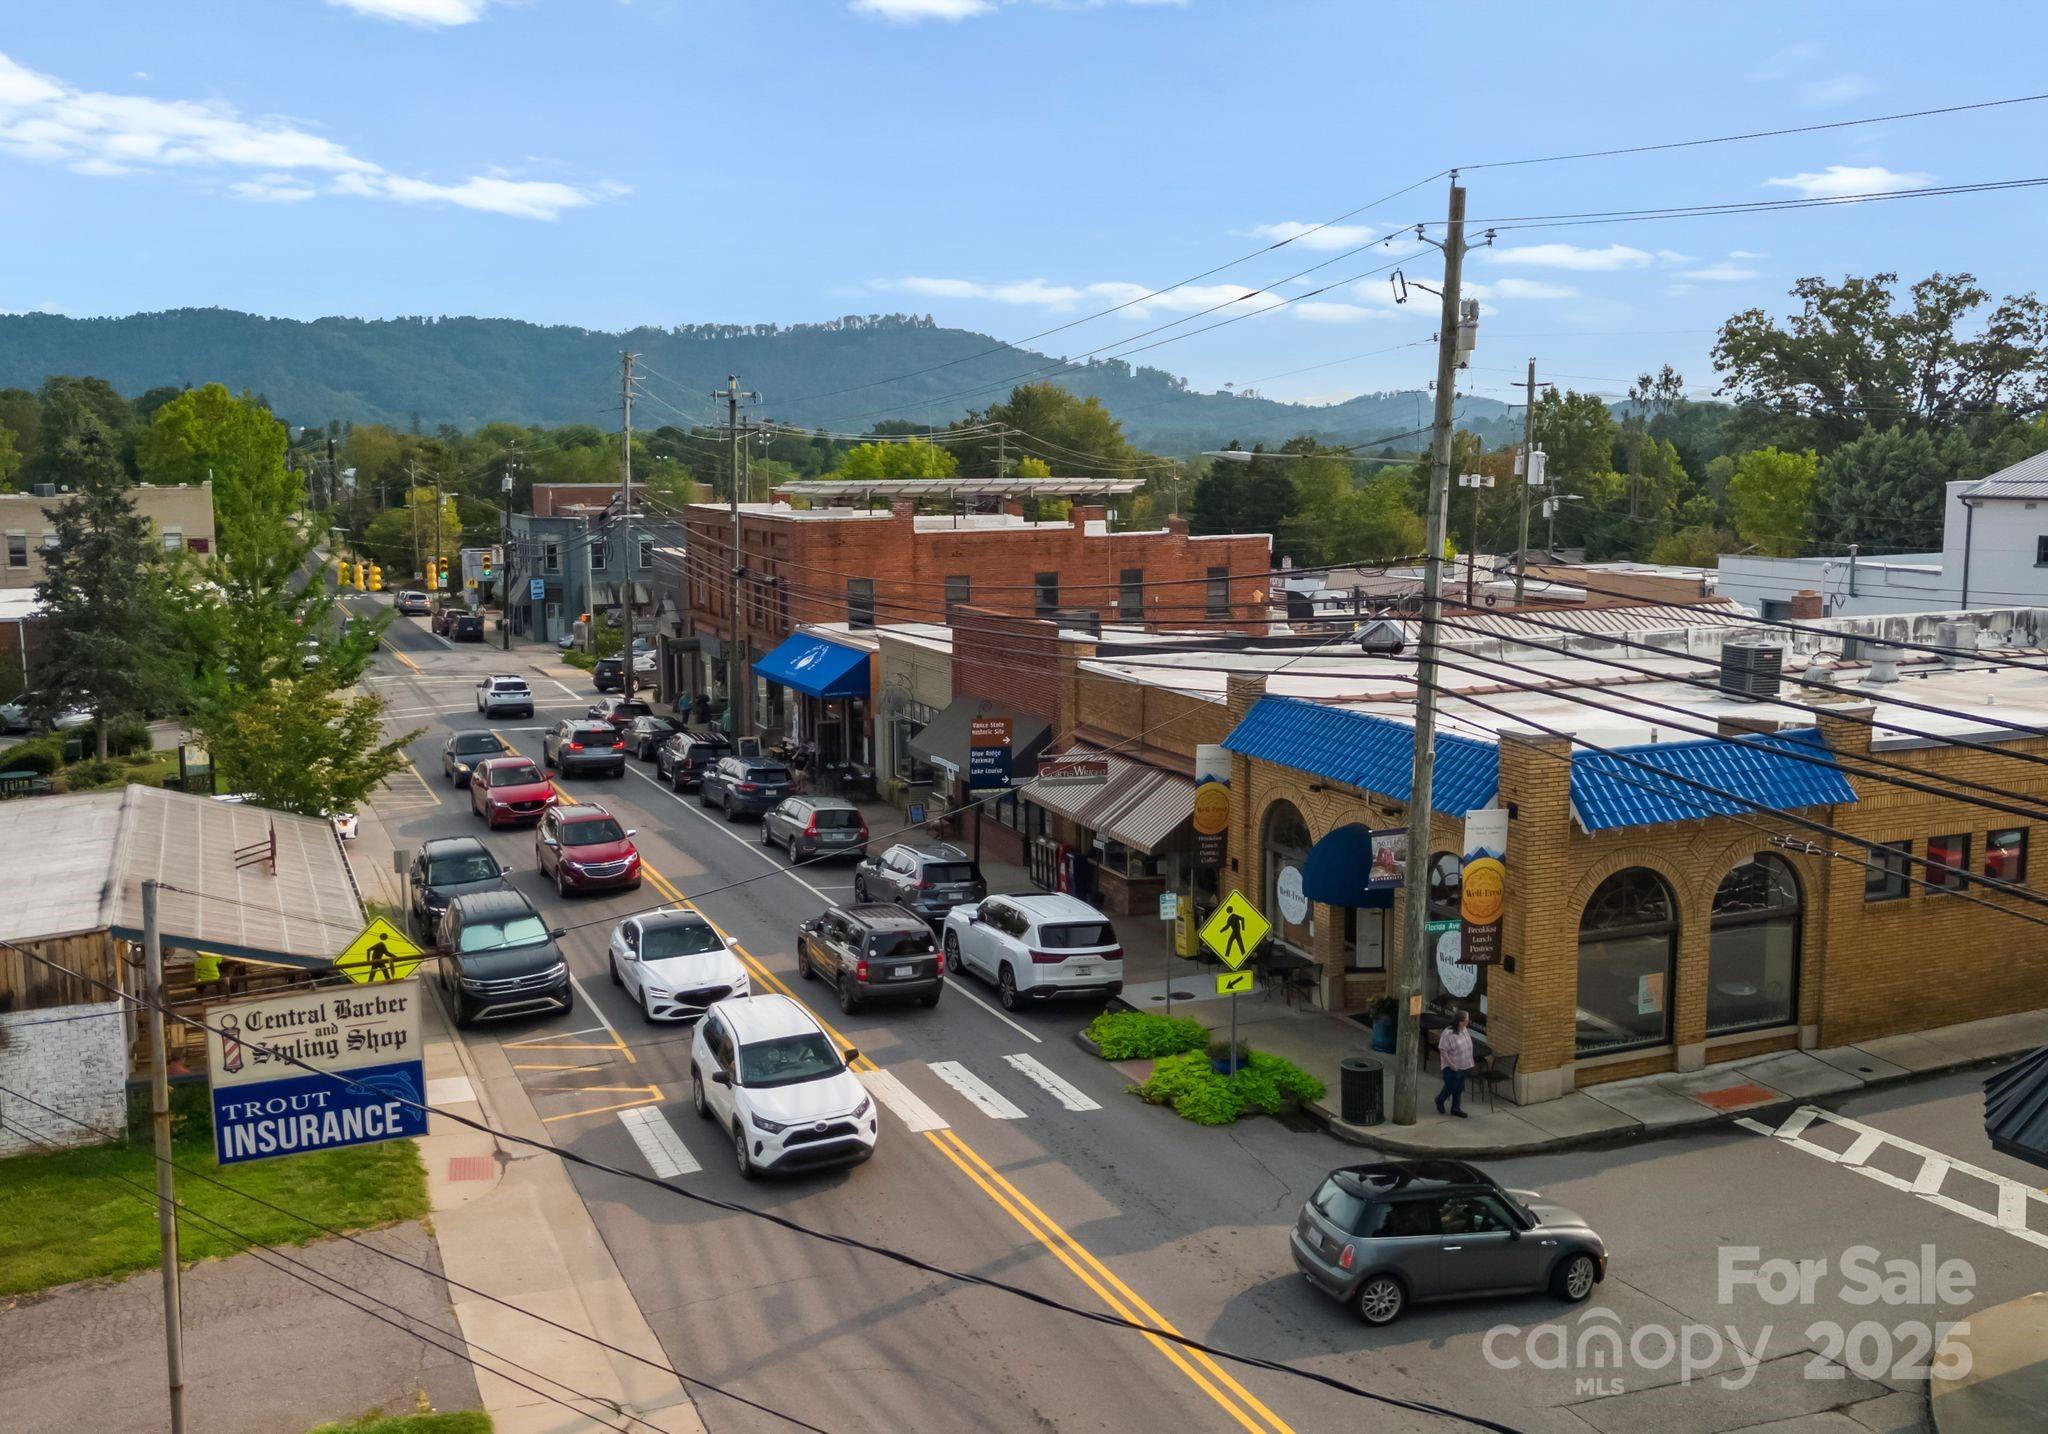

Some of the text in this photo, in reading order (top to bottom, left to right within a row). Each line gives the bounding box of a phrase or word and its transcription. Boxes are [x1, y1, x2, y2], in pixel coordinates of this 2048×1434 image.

[1424, 923, 1446, 931] Florida
[1468, 926, 1497, 934] Breakfast
[1472, 935, 1492, 943] Lunch
[1470, 945, 1494, 953] Pastries
[1471, 953, 1492, 961] Coffee
[245, 996, 408, 1031] Central Barber
[315, 1023, 339, 1037] and
[252, 1028, 408, 1065] Styling Shop
[222, 1091, 331, 1120] TROUT
[223, 1102, 403, 1158] INSURANCE
